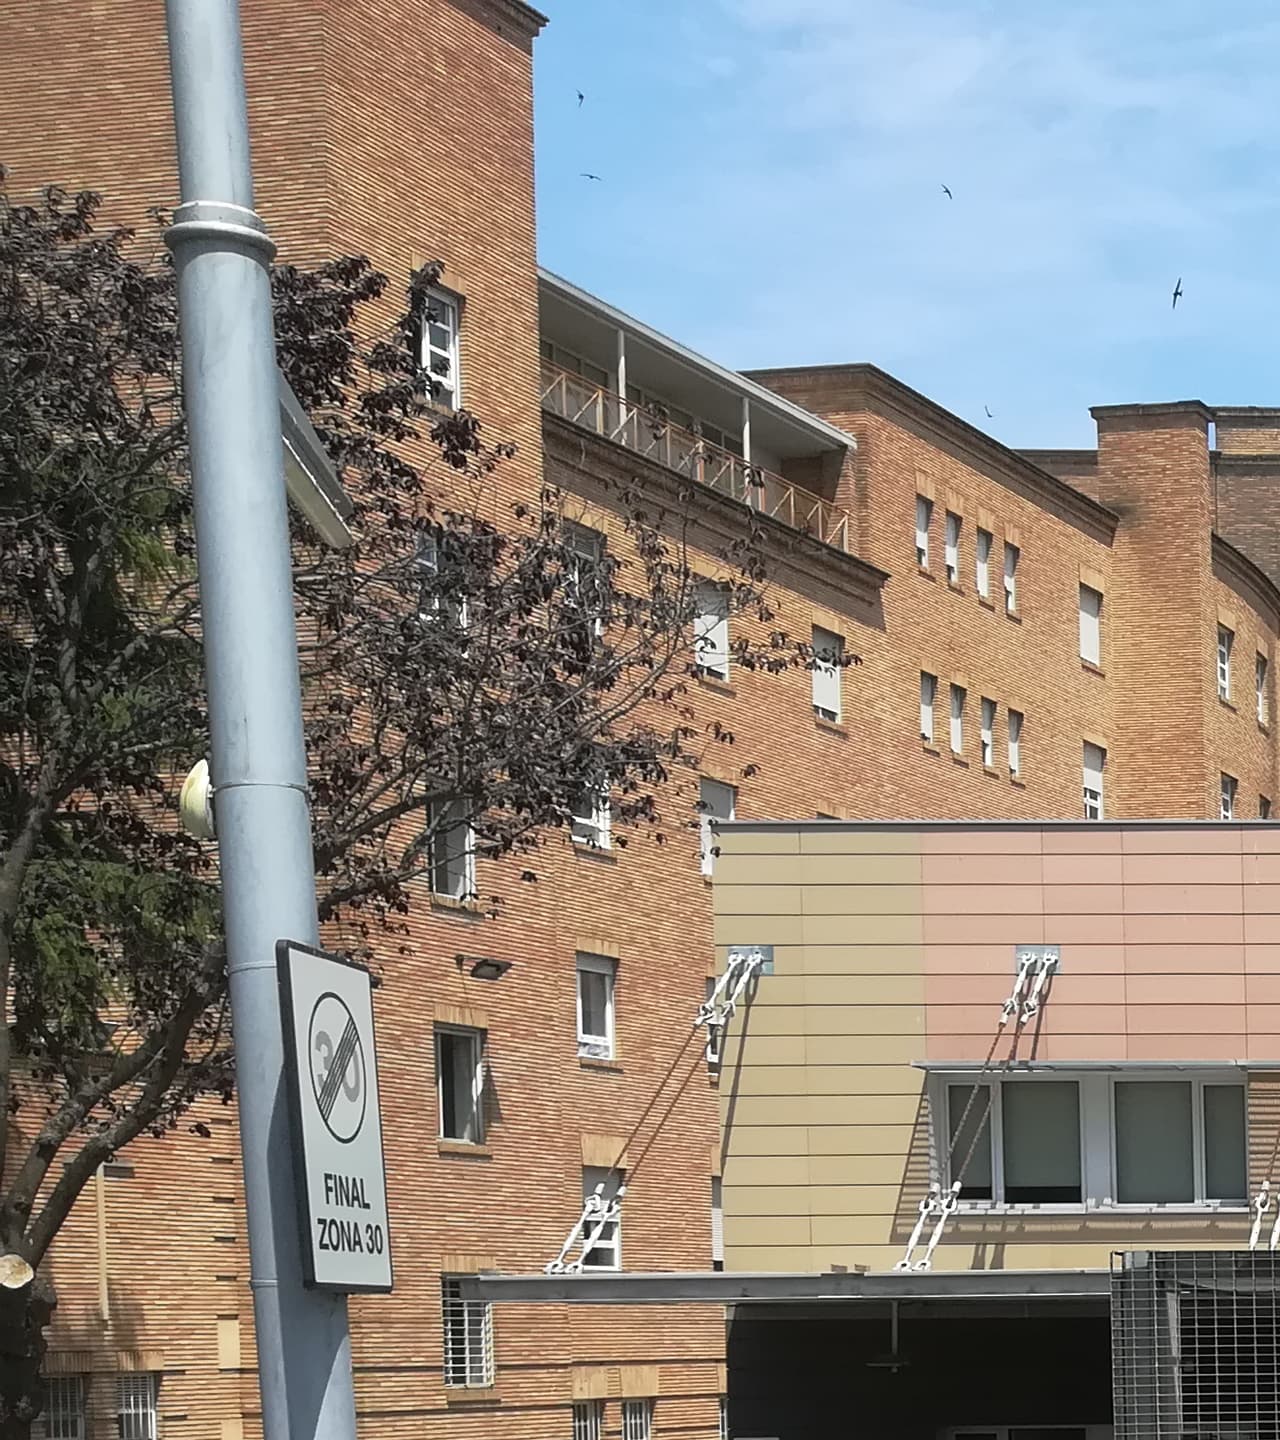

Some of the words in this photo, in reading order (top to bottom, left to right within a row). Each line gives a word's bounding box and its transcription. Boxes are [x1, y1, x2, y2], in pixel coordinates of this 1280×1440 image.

[323, 1172, 371, 1210] FINAL
[317, 1217, 364, 1254] ZONA
[365, 1223, 383, 1255] 30
